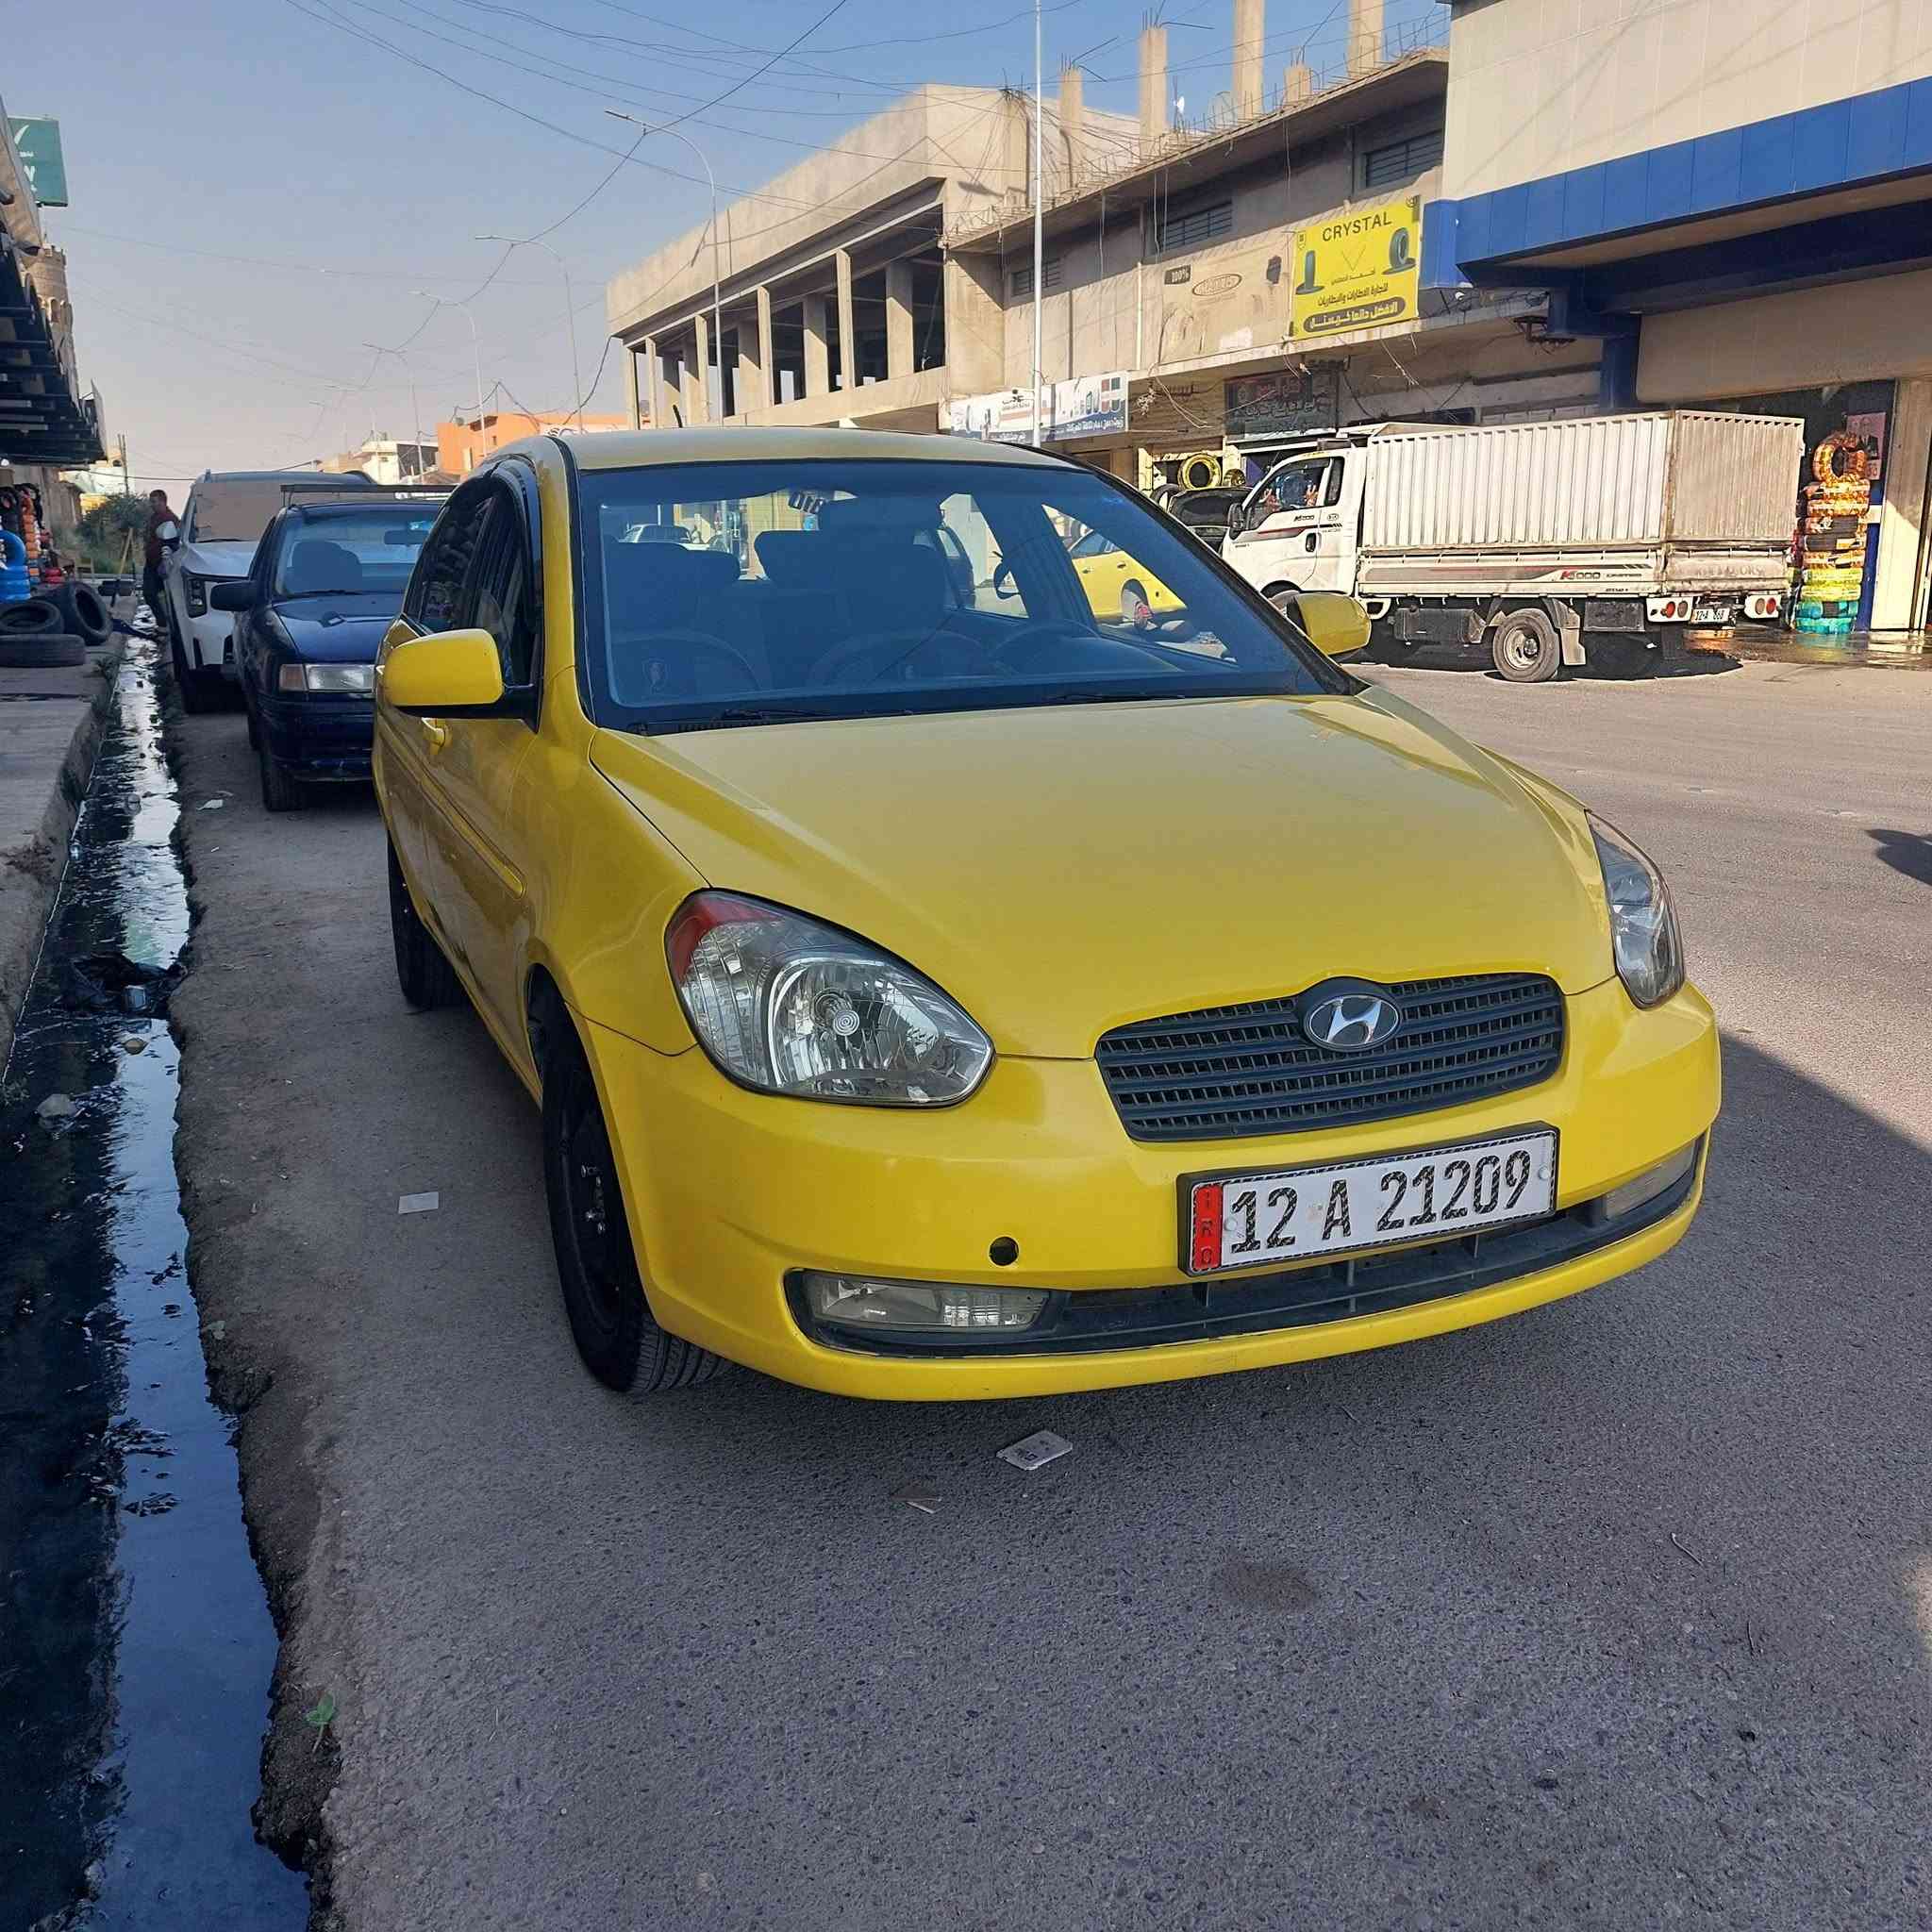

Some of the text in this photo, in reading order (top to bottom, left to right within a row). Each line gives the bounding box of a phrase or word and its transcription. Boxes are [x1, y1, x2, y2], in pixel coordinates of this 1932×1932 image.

[1322, 210, 1392, 242] CRYSTAL
[1171, 267, 1190, 282] 100%
[1230, 1148, 1532, 1254] 12 A 21209
